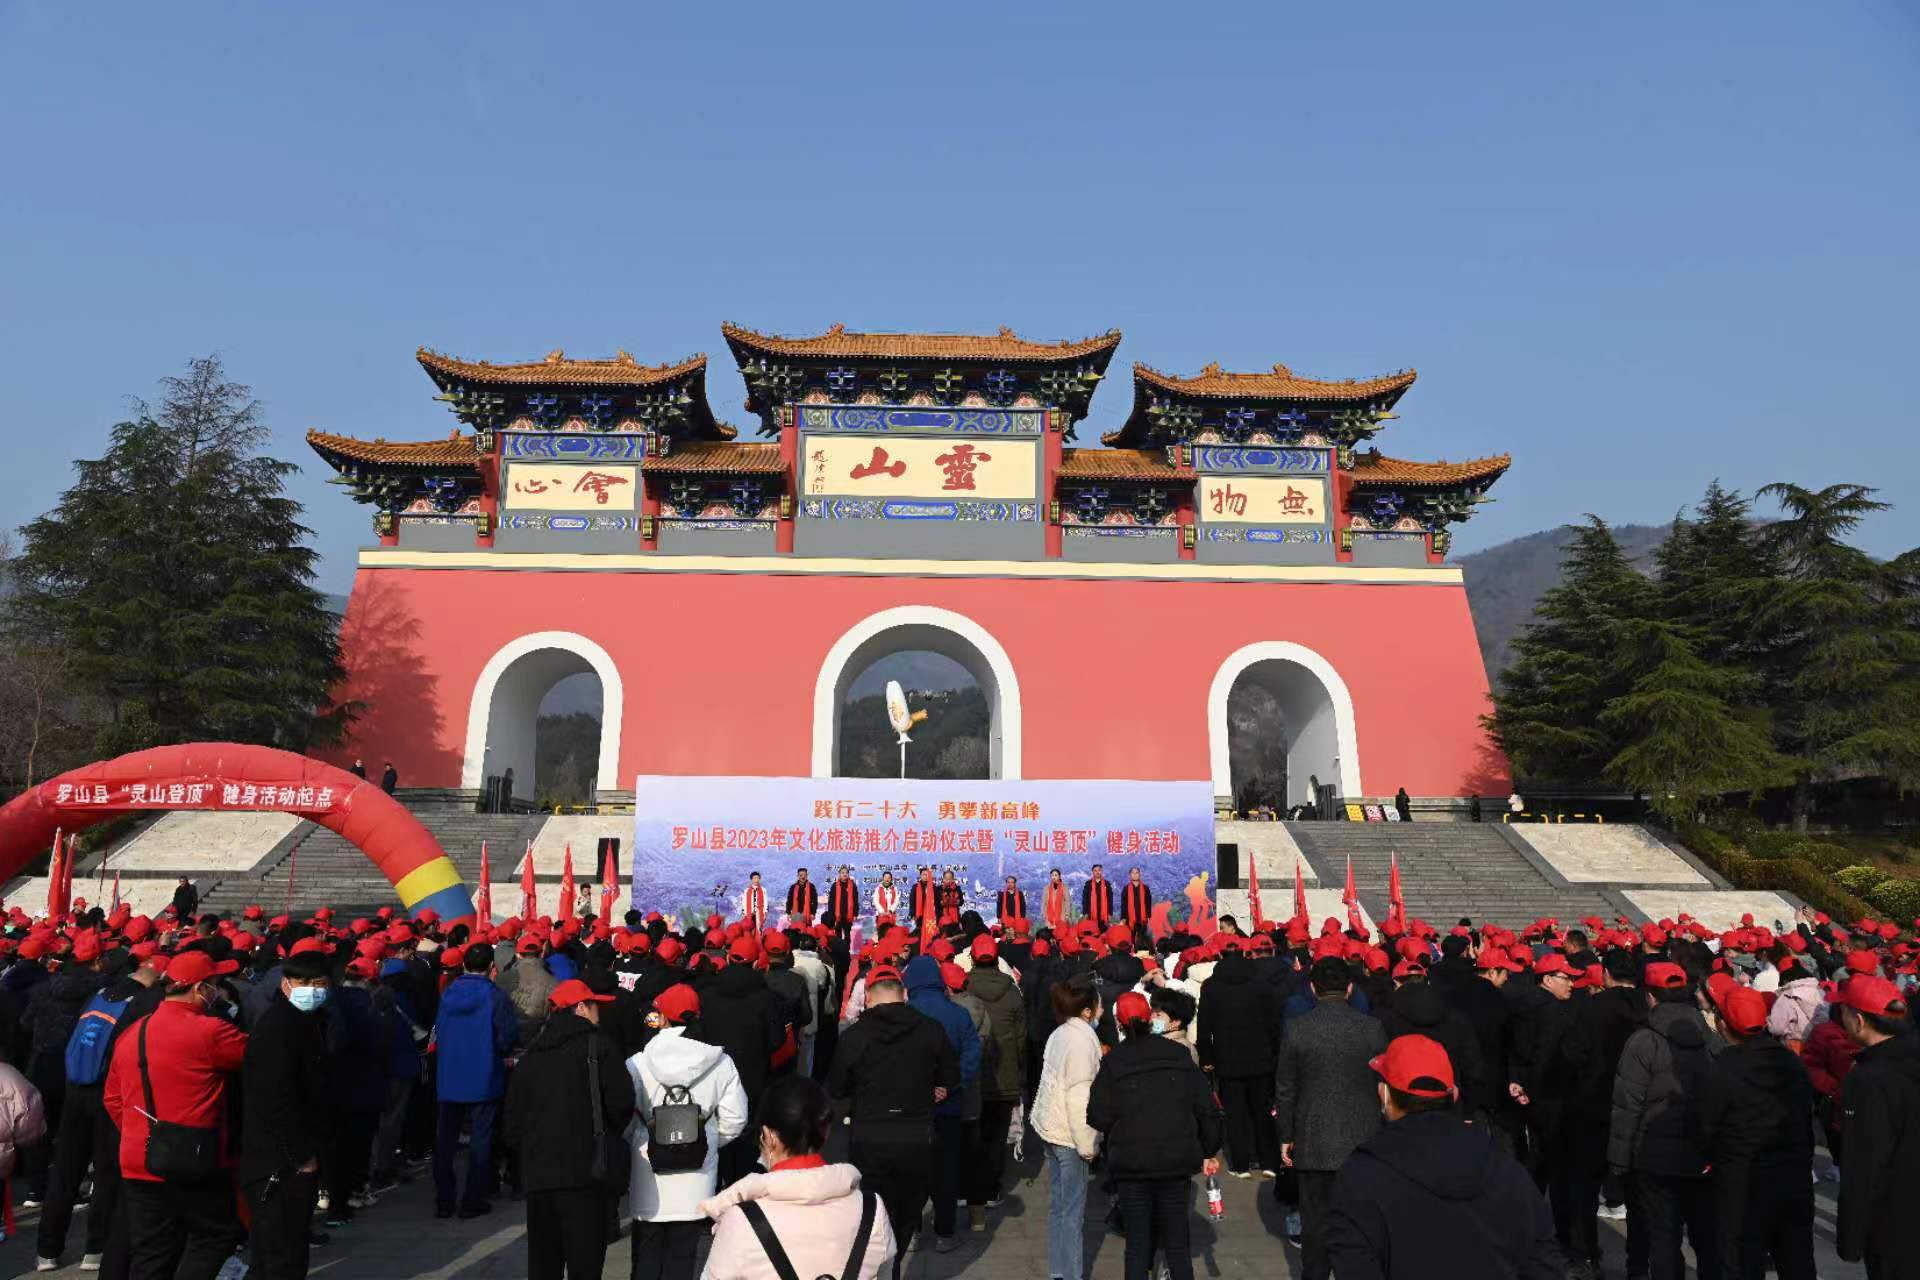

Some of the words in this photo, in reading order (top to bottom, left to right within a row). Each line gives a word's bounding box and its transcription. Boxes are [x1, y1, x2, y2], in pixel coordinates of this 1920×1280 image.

[814, 800, 918, 819] 践行二十大
[938, 801, 1041, 820] 勇攀新高峰
